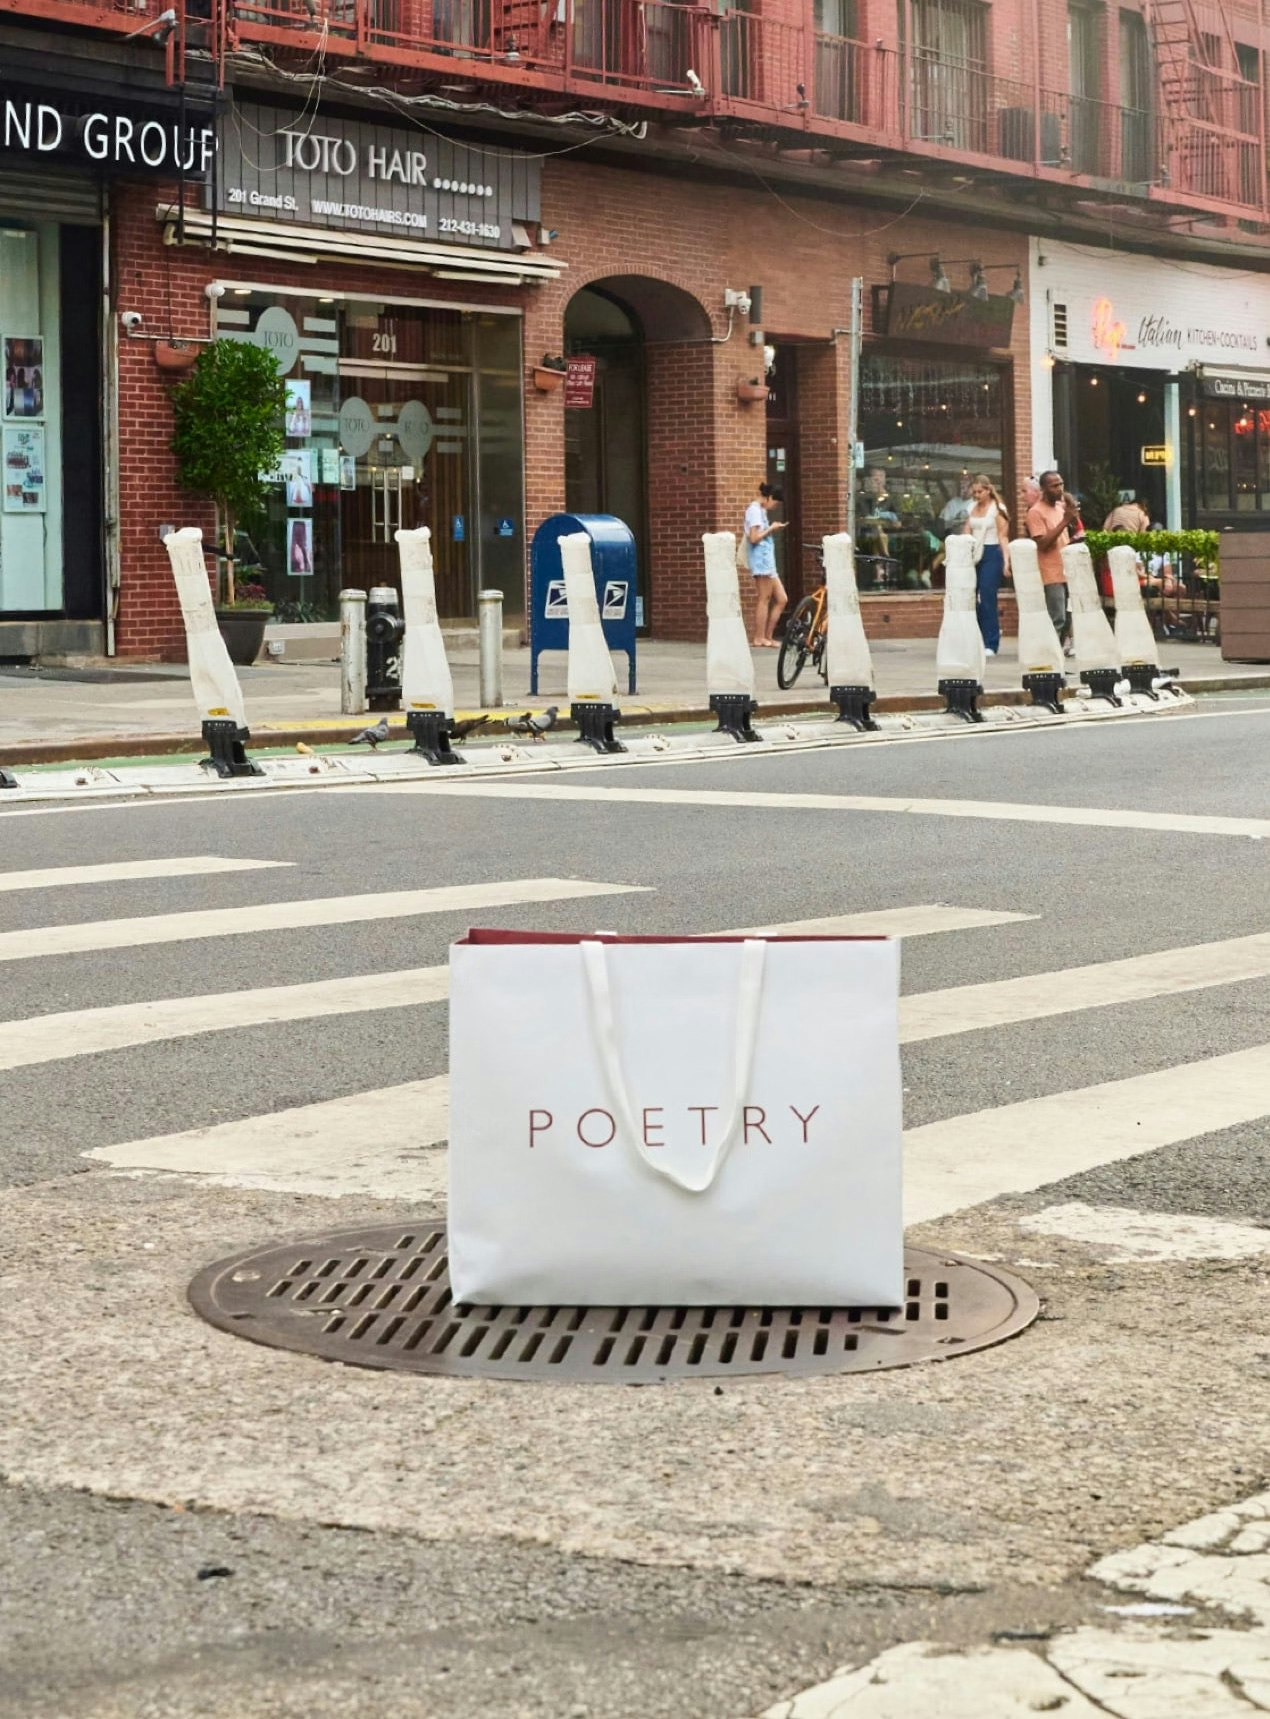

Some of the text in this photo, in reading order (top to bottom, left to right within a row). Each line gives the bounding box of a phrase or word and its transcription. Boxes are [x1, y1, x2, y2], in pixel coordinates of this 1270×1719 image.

[5, 100, 219, 172] ND GROUP
[277, 130, 356, 175] TOTO
[368, 145, 426, 186] HAIR
[228, 188, 299, 211] 201 Grand St.
[311, 199, 427, 228] WWW.TOTOHAIRS.COM
[263, 331, 294, 348] TOTO
[372, 333, 397, 353] 201
[1138, 313, 1183, 350] Italian
[344, 418, 369, 433] TOTO
[529, 1104, 821, 1148] POETRY
